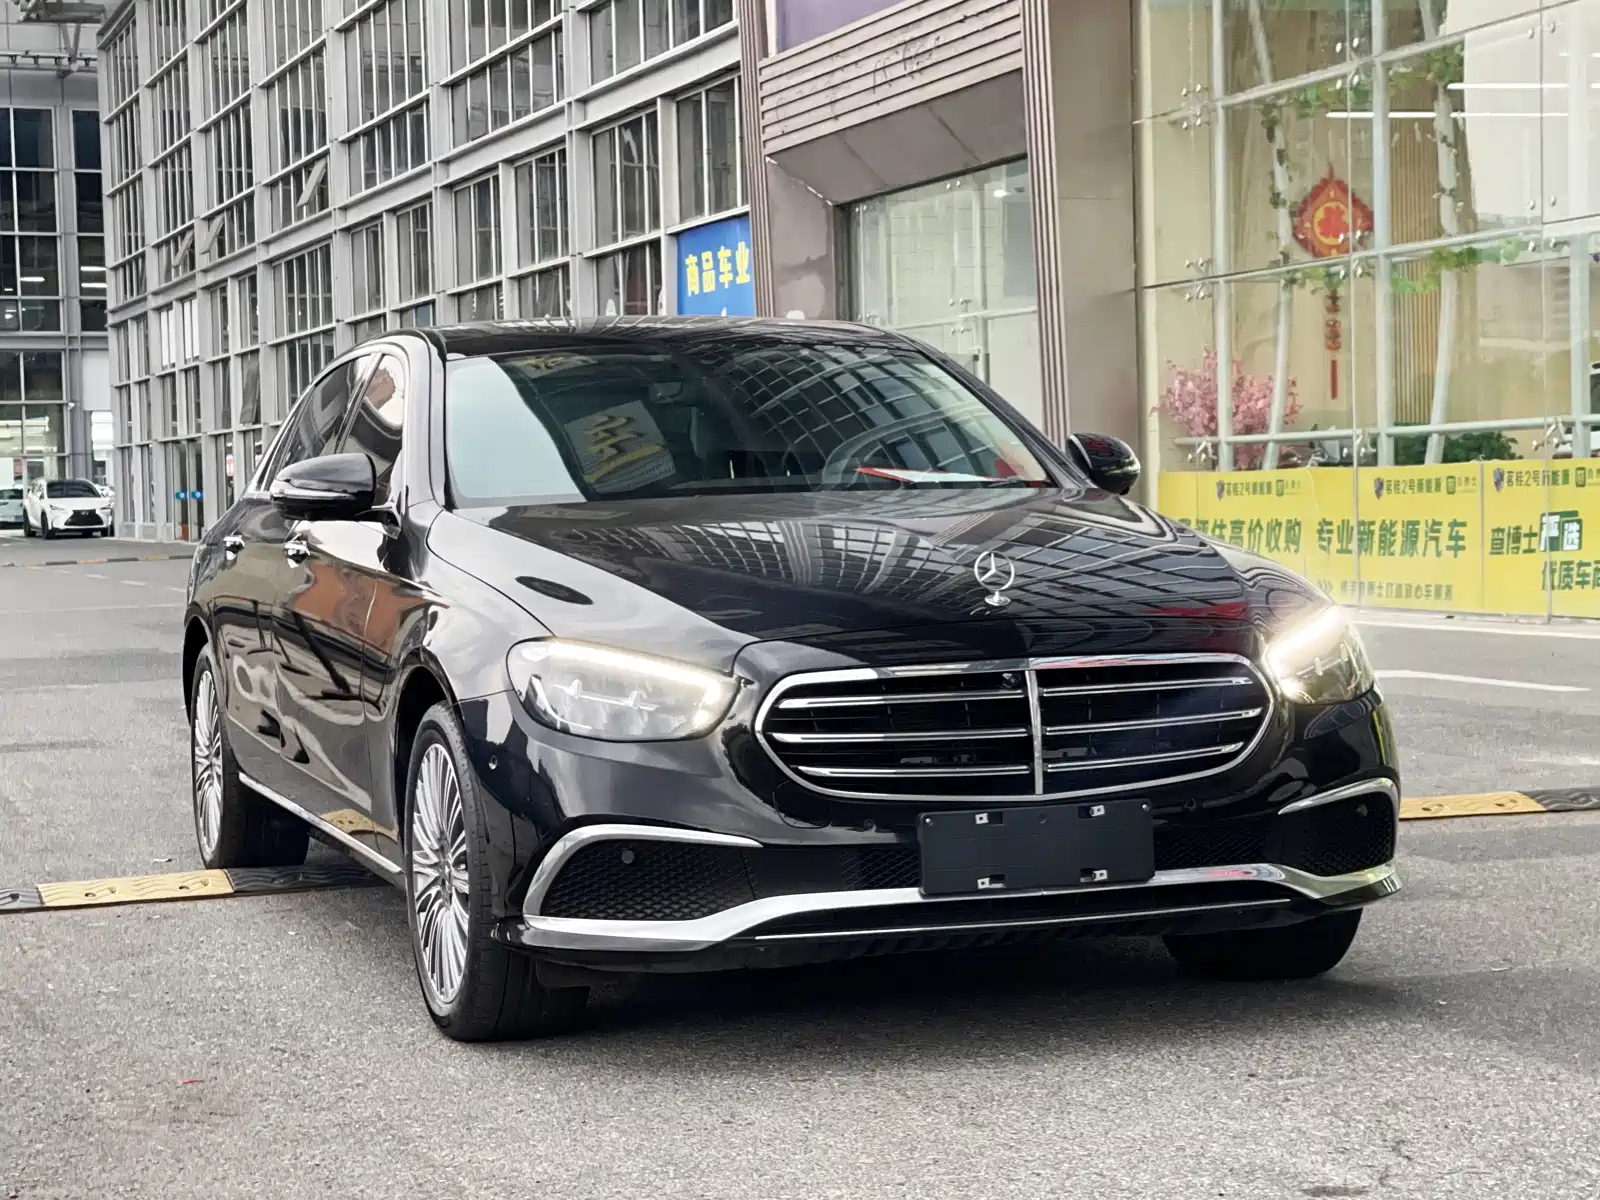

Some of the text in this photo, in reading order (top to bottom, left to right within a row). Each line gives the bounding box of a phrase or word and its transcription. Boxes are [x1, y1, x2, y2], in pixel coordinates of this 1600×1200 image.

[1316, 517, 1467, 559] 专业新能源汽车
